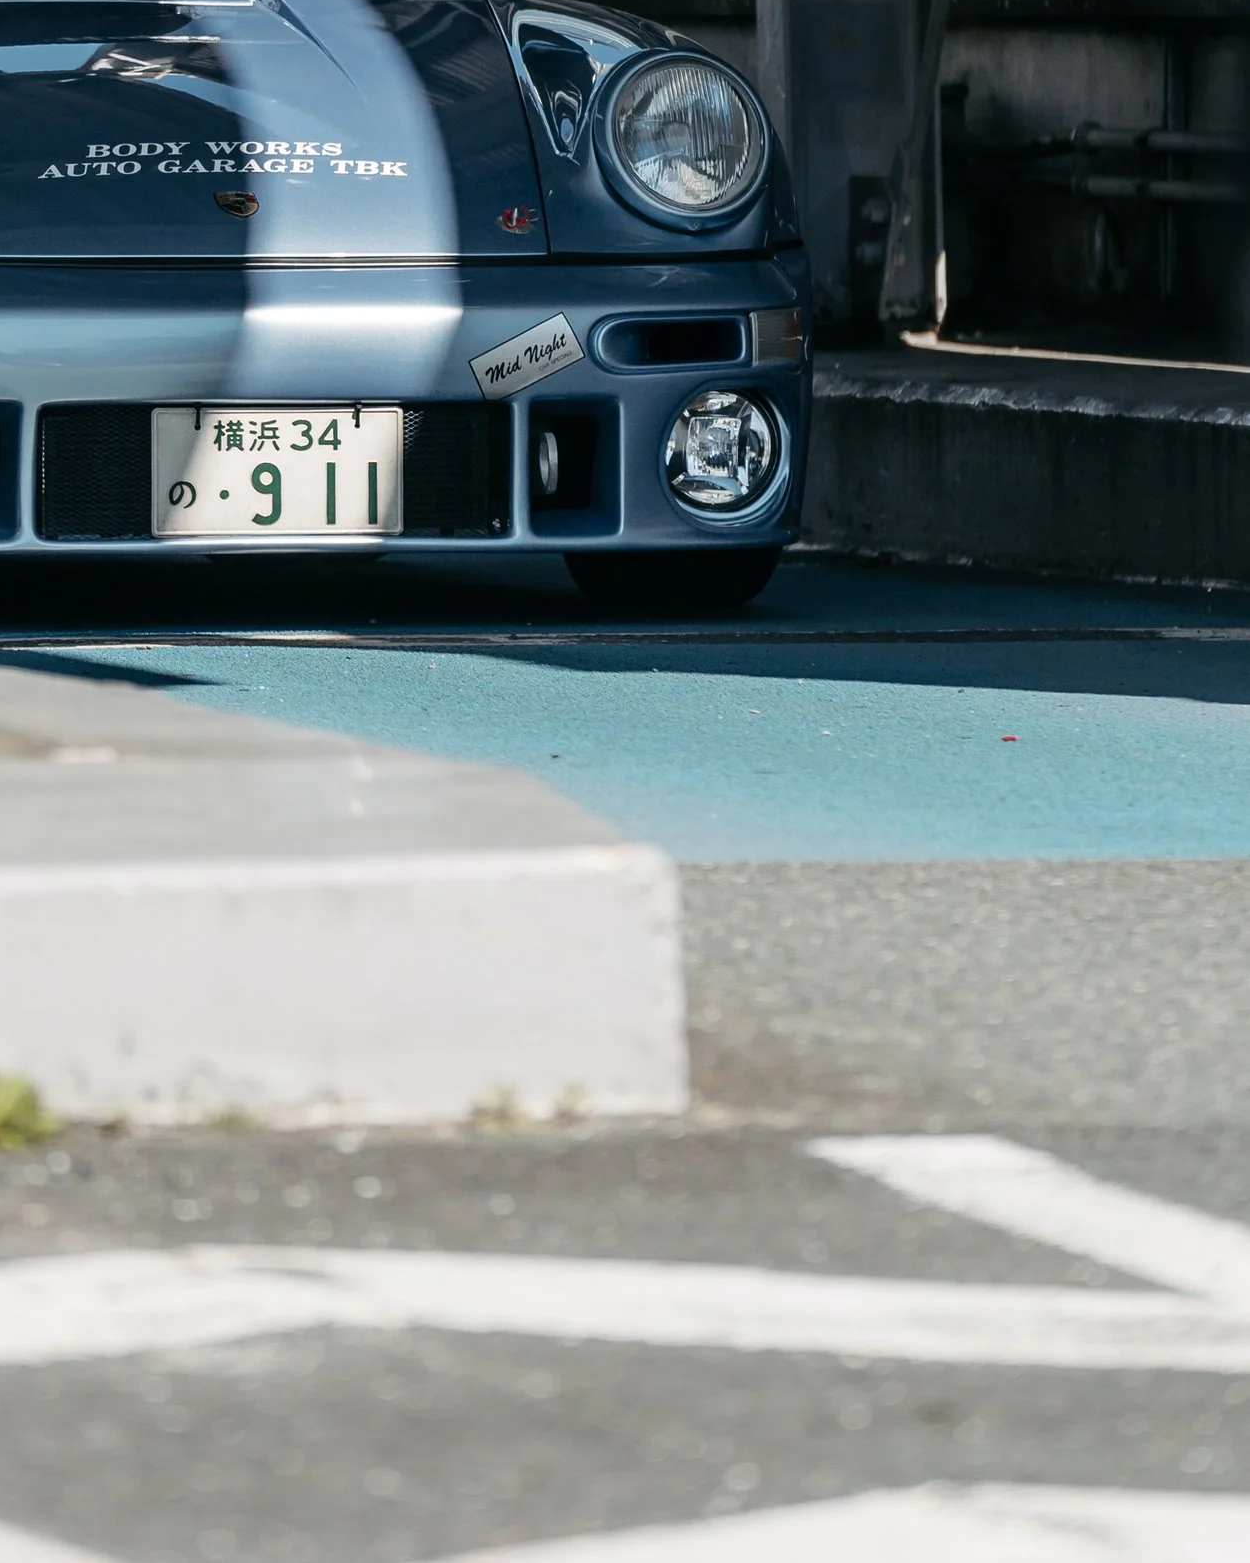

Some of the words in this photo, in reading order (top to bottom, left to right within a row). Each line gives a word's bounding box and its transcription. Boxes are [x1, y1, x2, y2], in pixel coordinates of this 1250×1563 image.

[85, 141, 191, 159] BODY
[204, 141, 344, 156] WORKS
[37, 161, 142, 179] AUTO
[157, 158, 315, 174] GARAGE
[330, 160, 409, 177] TBK
[485, 355, 522, 384] Mid
[524, 333, 568, 365] Night
[213, 418, 281, 452] 横浜
[289, 418, 342, 451] 34
[168, 480, 197, 509] の
